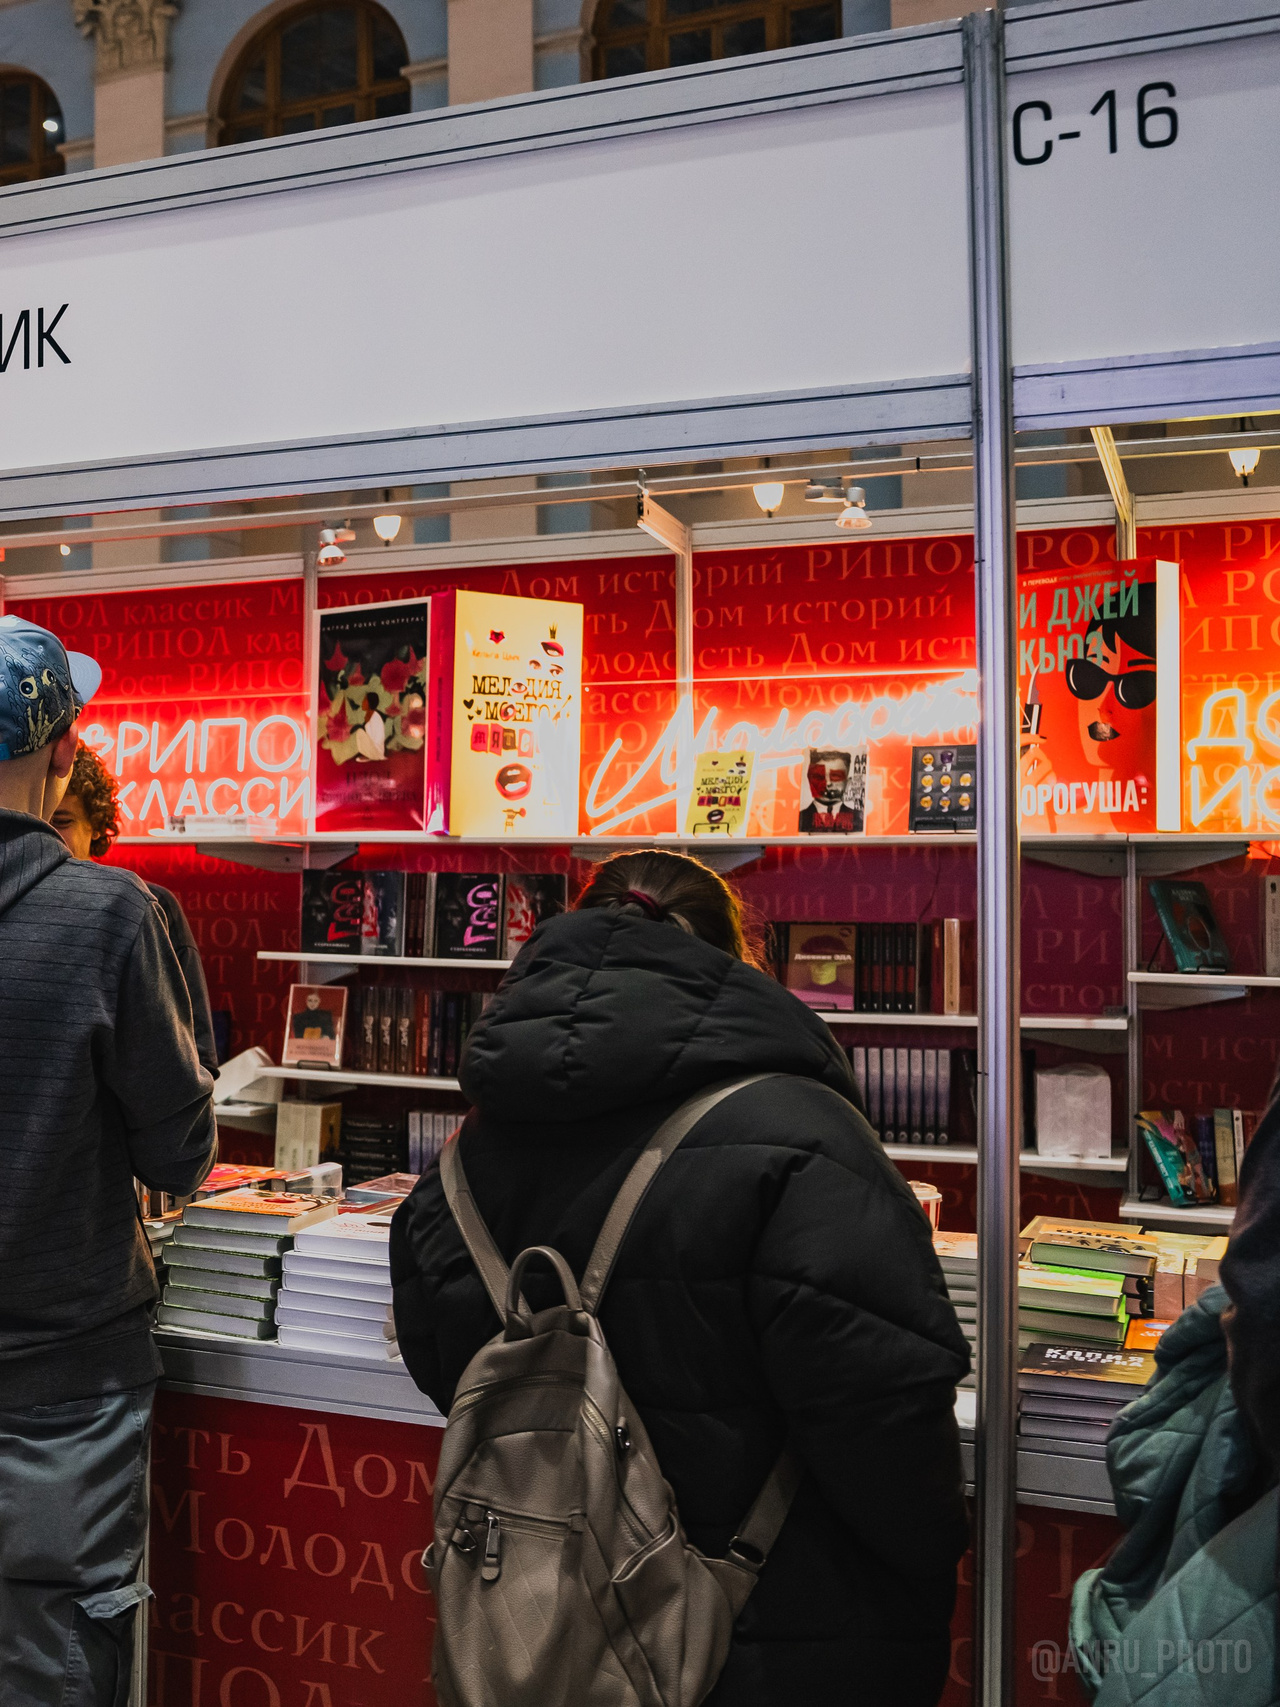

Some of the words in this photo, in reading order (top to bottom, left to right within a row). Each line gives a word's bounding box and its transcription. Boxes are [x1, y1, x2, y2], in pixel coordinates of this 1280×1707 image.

[1012, 81, 1179, 167] С-16
[500, 569, 580, 599] Дом
[805, 540, 976, 583] РИПО
[122, 597, 252, 627] классик
[766, 583, 955, 631] историй
[1046, 568, 1140, 634] ДЖЕЙ
[92, 626, 232, 661] РИПОЛ
[782, 632, 877, 675] Дом
[151, 1591, 386, 1675] ассик
